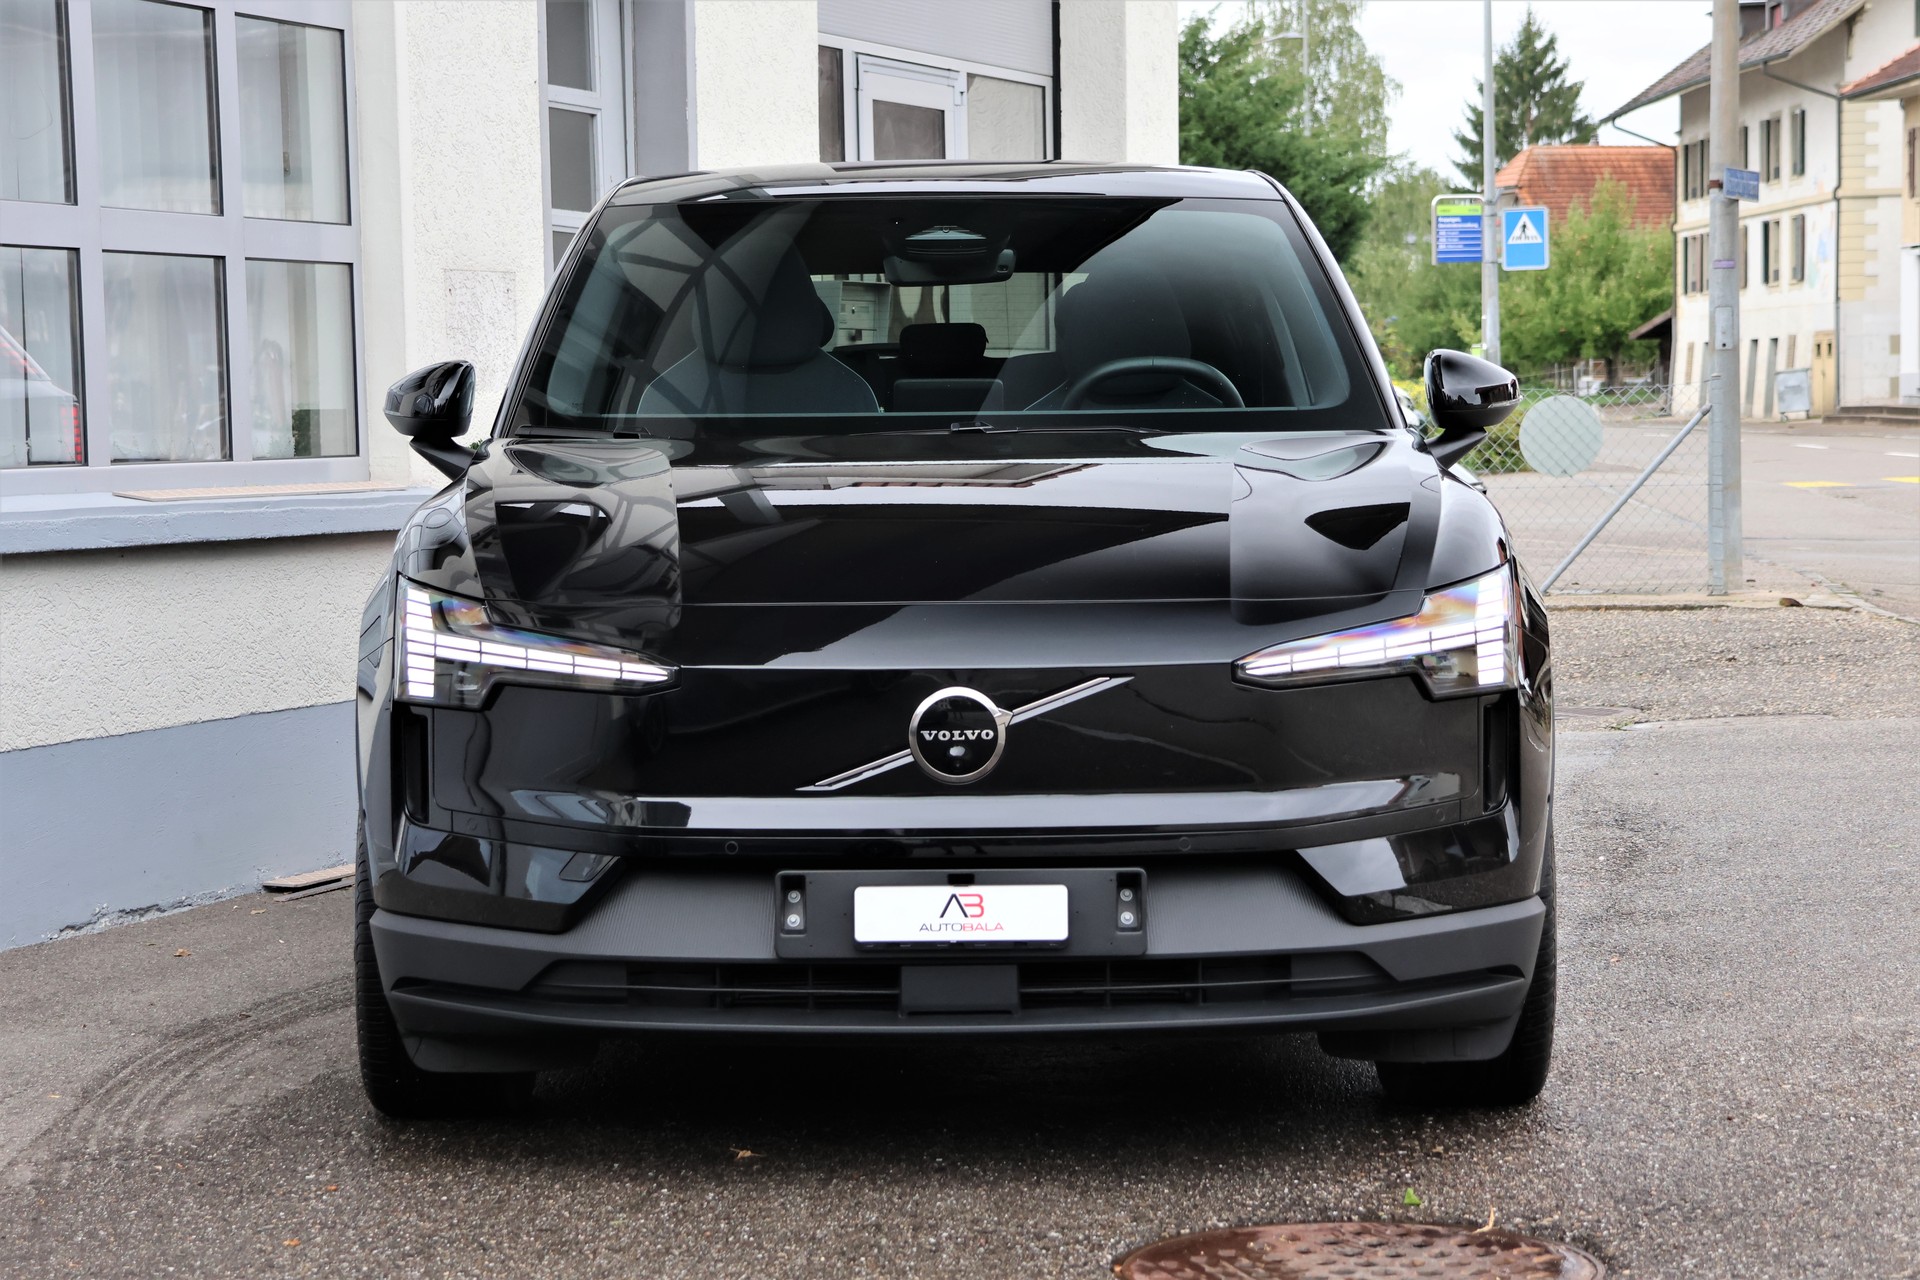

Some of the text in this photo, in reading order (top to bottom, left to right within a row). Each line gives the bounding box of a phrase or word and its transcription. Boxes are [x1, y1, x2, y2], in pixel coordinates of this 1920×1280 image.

[920, 729, 994, 741] VOLVO
[939, 893, 985, 918] AB
[919, 922, 1004, 932] AUTOBALA
